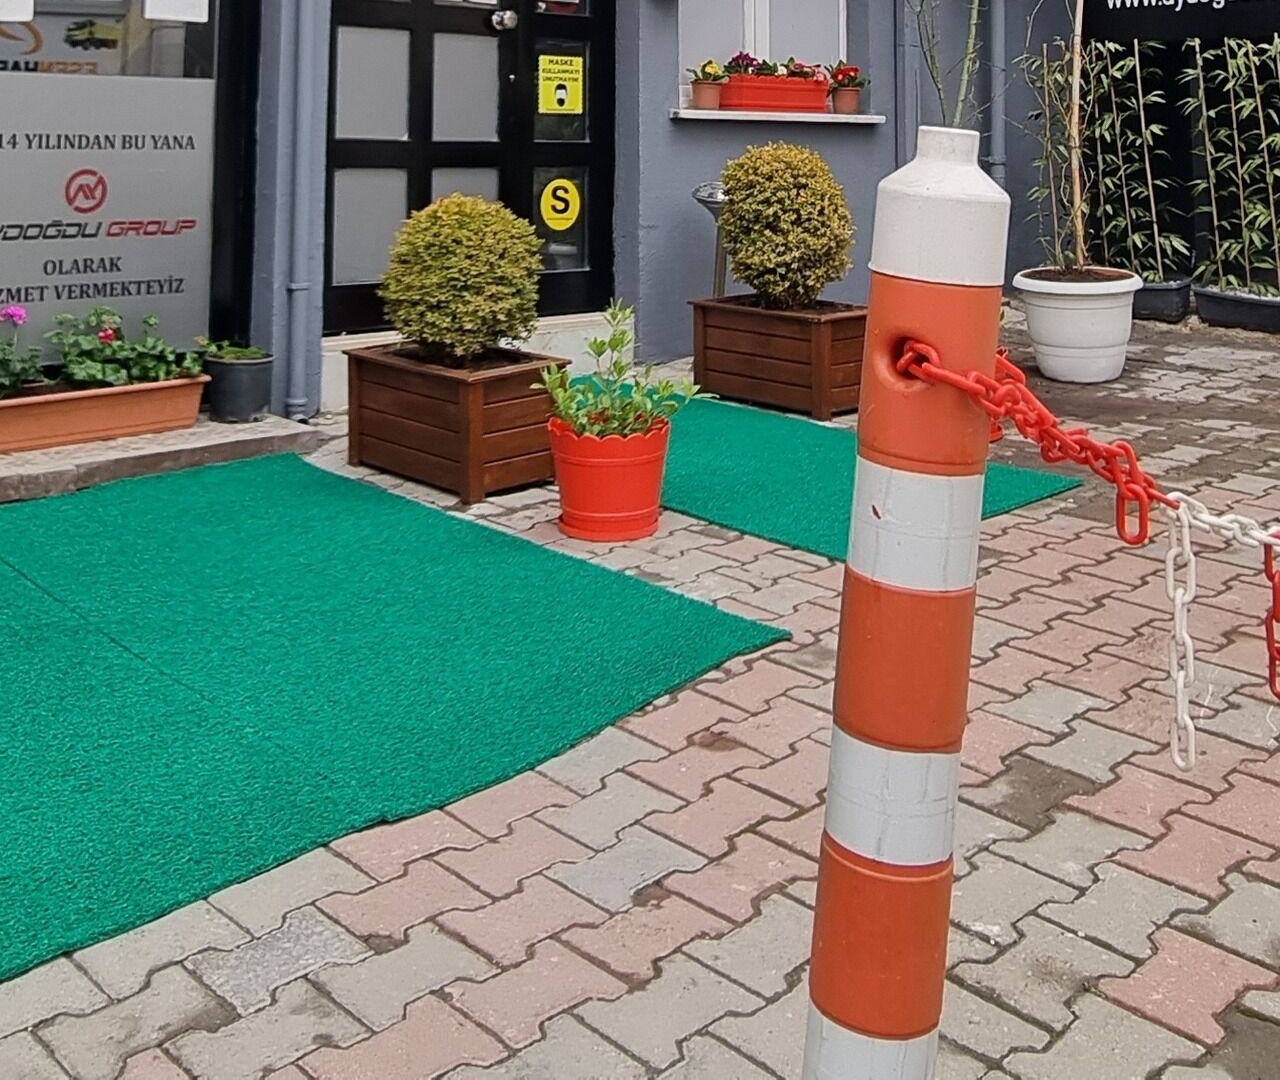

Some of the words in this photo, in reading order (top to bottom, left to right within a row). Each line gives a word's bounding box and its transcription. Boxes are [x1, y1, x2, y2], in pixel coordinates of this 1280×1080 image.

[548, 58, 573, 67] MASKE
[24, 133, 116, 151] YILINDAN
[121, 134, 147, 151] BU
[151, 134, 196, 151] YANA
[550, 185, 570, 215] S
[105, 219, 197, 239] GROUP
[43, 256, 123, 276] OLARAK
[54, 275, 185, 301] VERMEKTEYİZ
